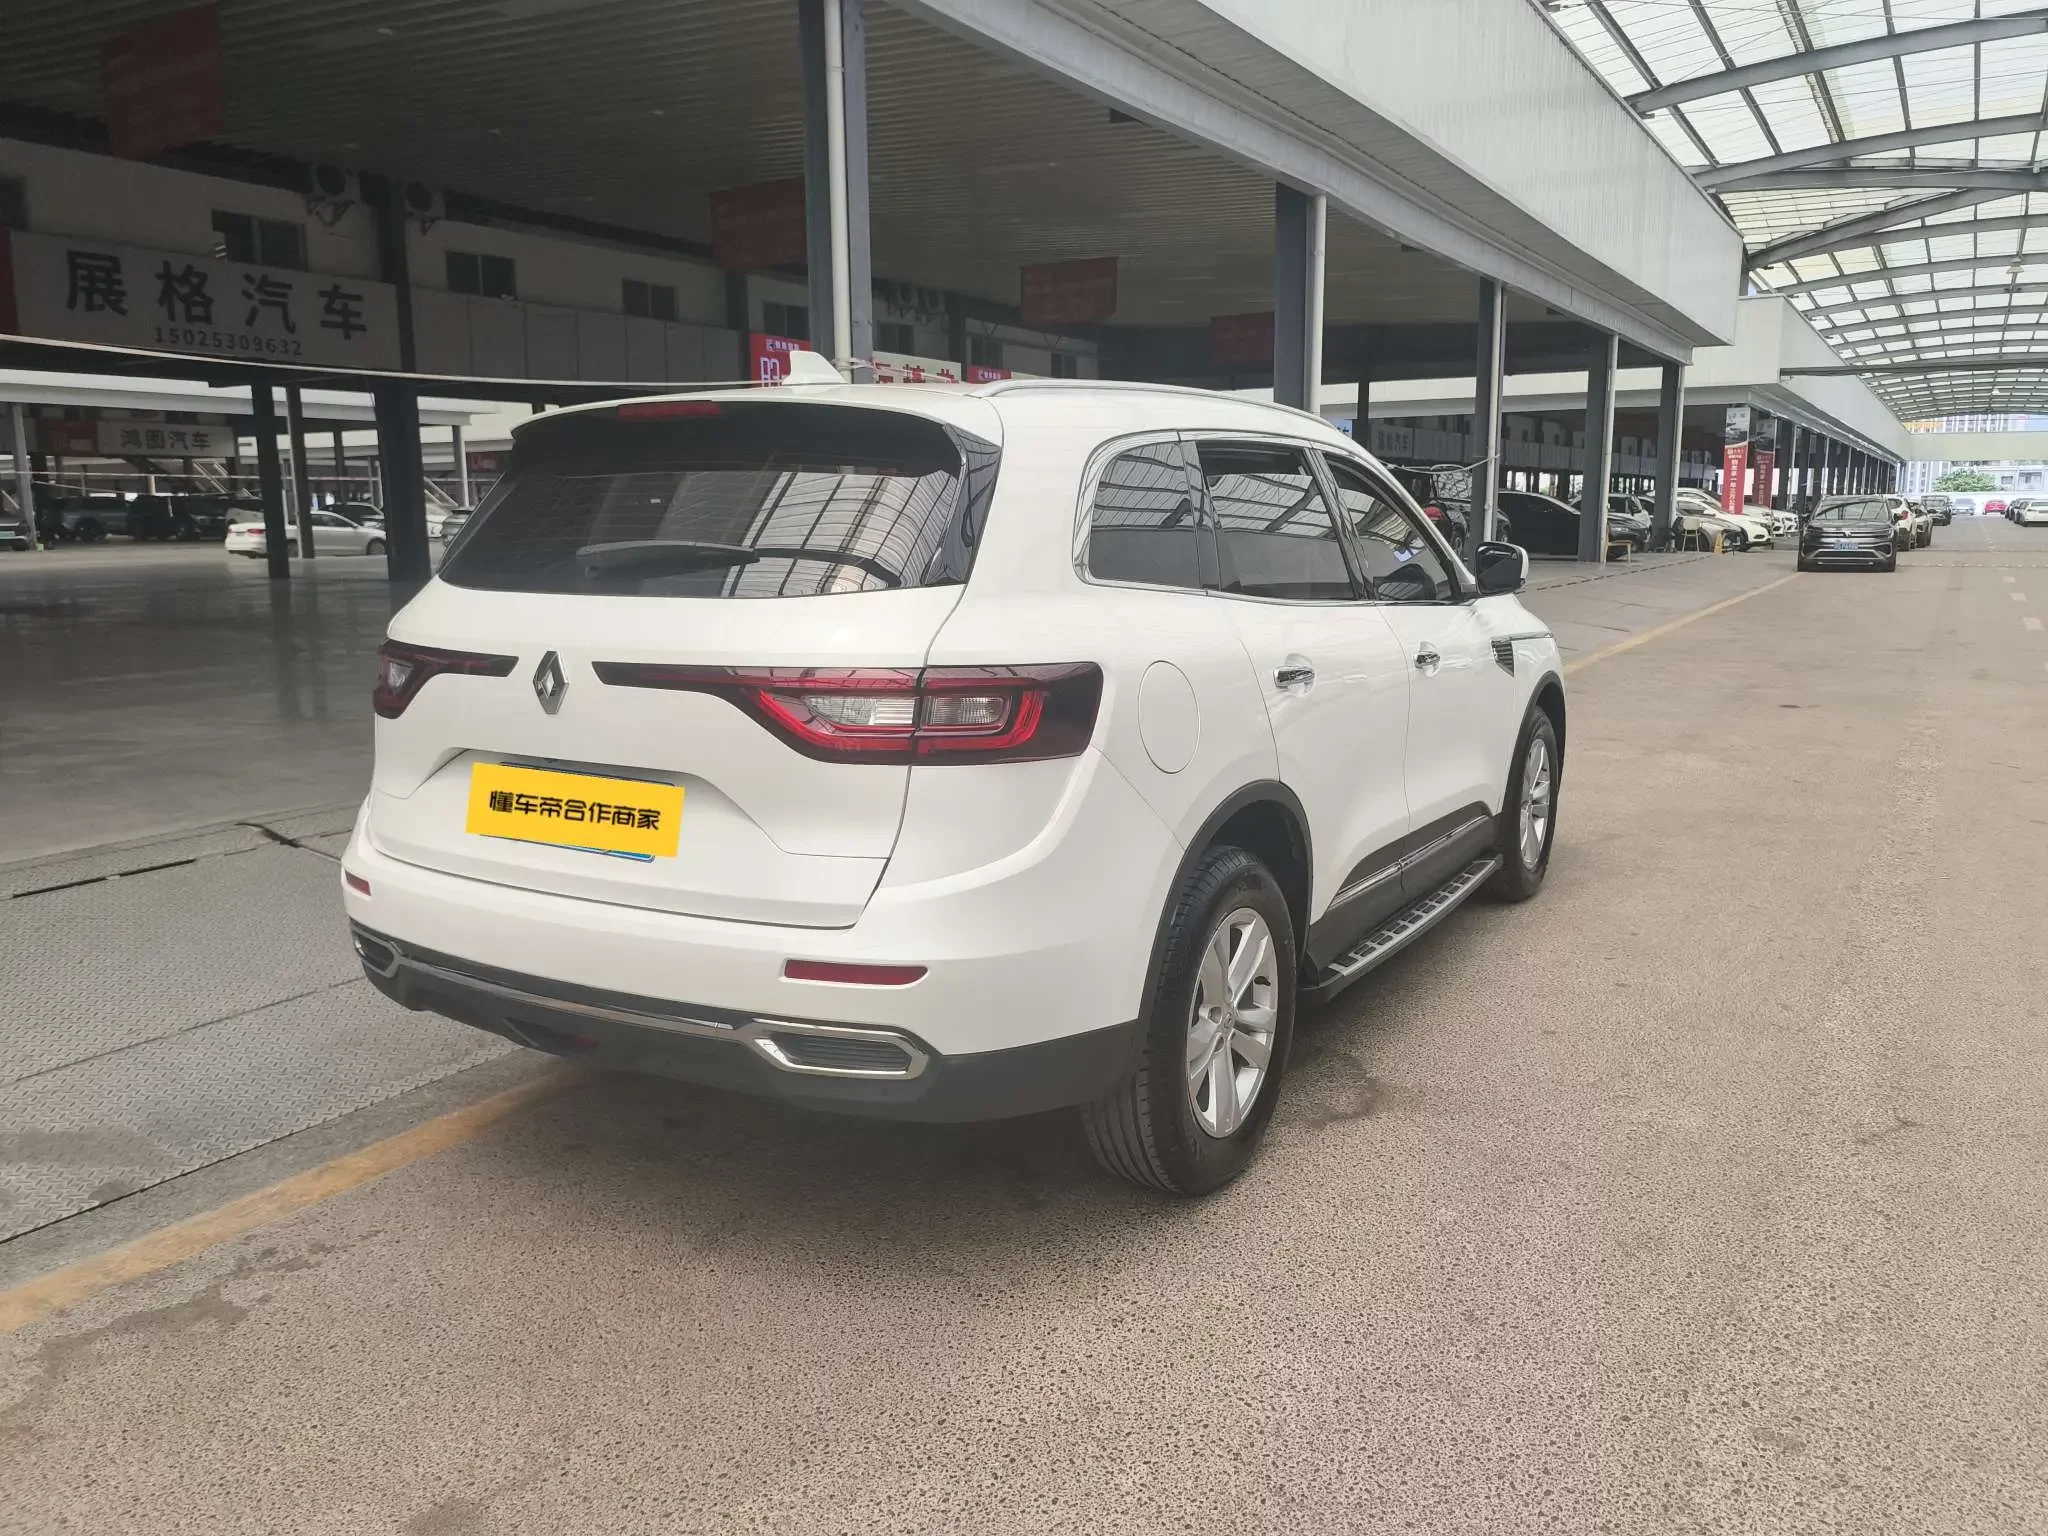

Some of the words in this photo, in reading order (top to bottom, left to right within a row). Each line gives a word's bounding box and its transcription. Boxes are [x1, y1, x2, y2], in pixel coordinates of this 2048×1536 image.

[66, 249, 368, 341] 展格汽车
[154, 326, 304, 357] 15025309632
